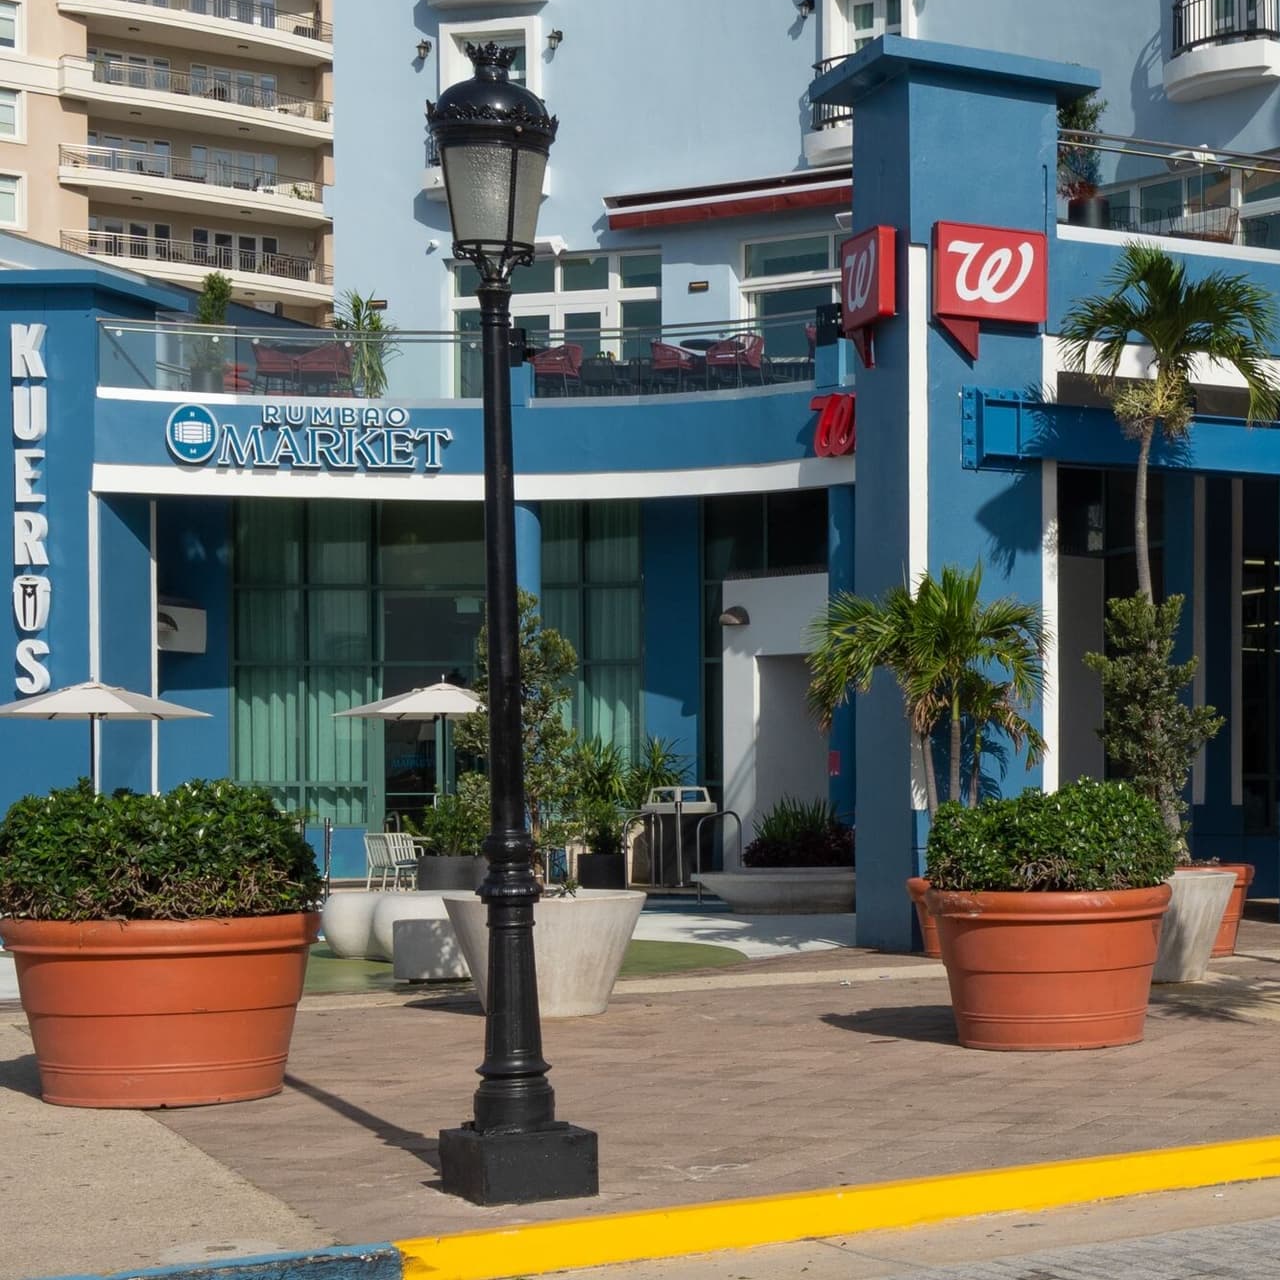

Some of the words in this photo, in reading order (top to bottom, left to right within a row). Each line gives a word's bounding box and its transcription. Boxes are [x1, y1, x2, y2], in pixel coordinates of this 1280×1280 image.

[845, 239, 876, 313] W
[947, 240, 1034, 303] W
[217, 424, 453, 468] MARKET
[262, 404, 408, 427] RUMBAO
[11, 323, 52, 695] KUEROS
